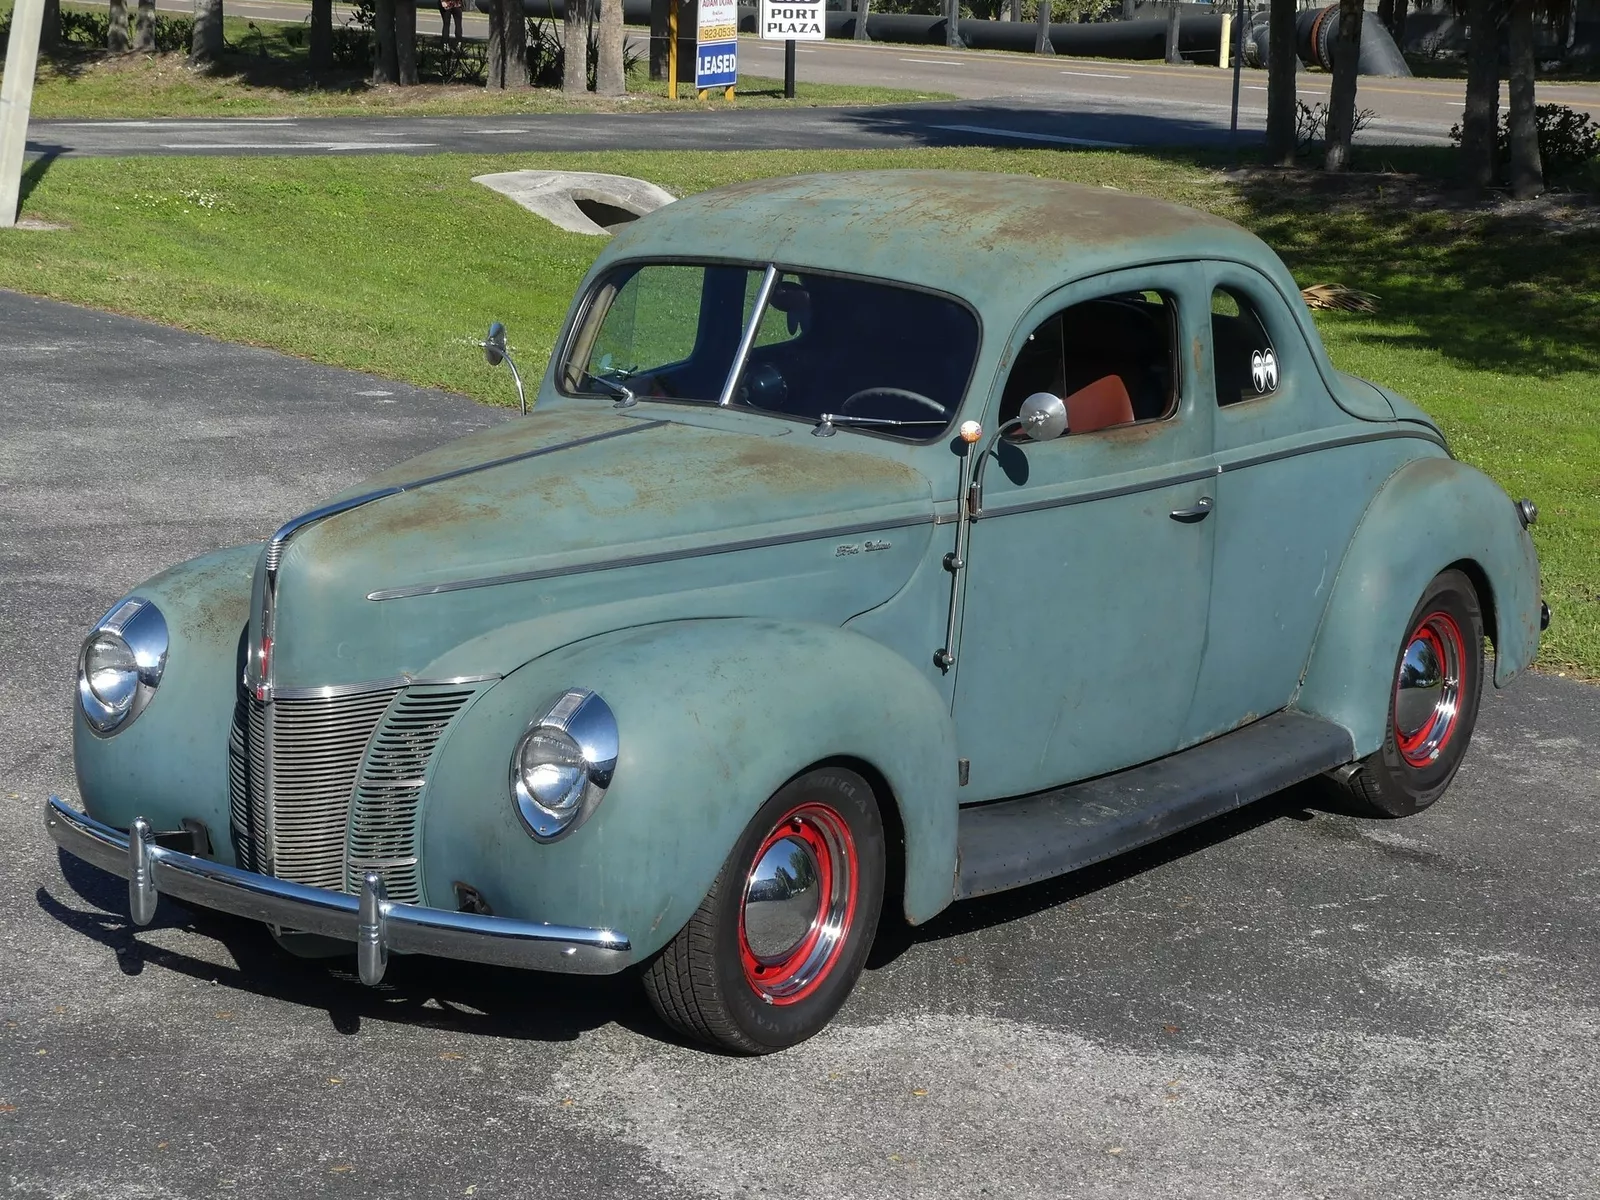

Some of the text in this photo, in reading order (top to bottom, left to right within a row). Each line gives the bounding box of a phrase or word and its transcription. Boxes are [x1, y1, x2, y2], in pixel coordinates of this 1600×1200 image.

[771, 8, 819, 19] PORT
[704, 26, 736, 39] 923-0535
[767, 22, 821, 34] PLAZA
[698, 53, 736, 75] LEASED
